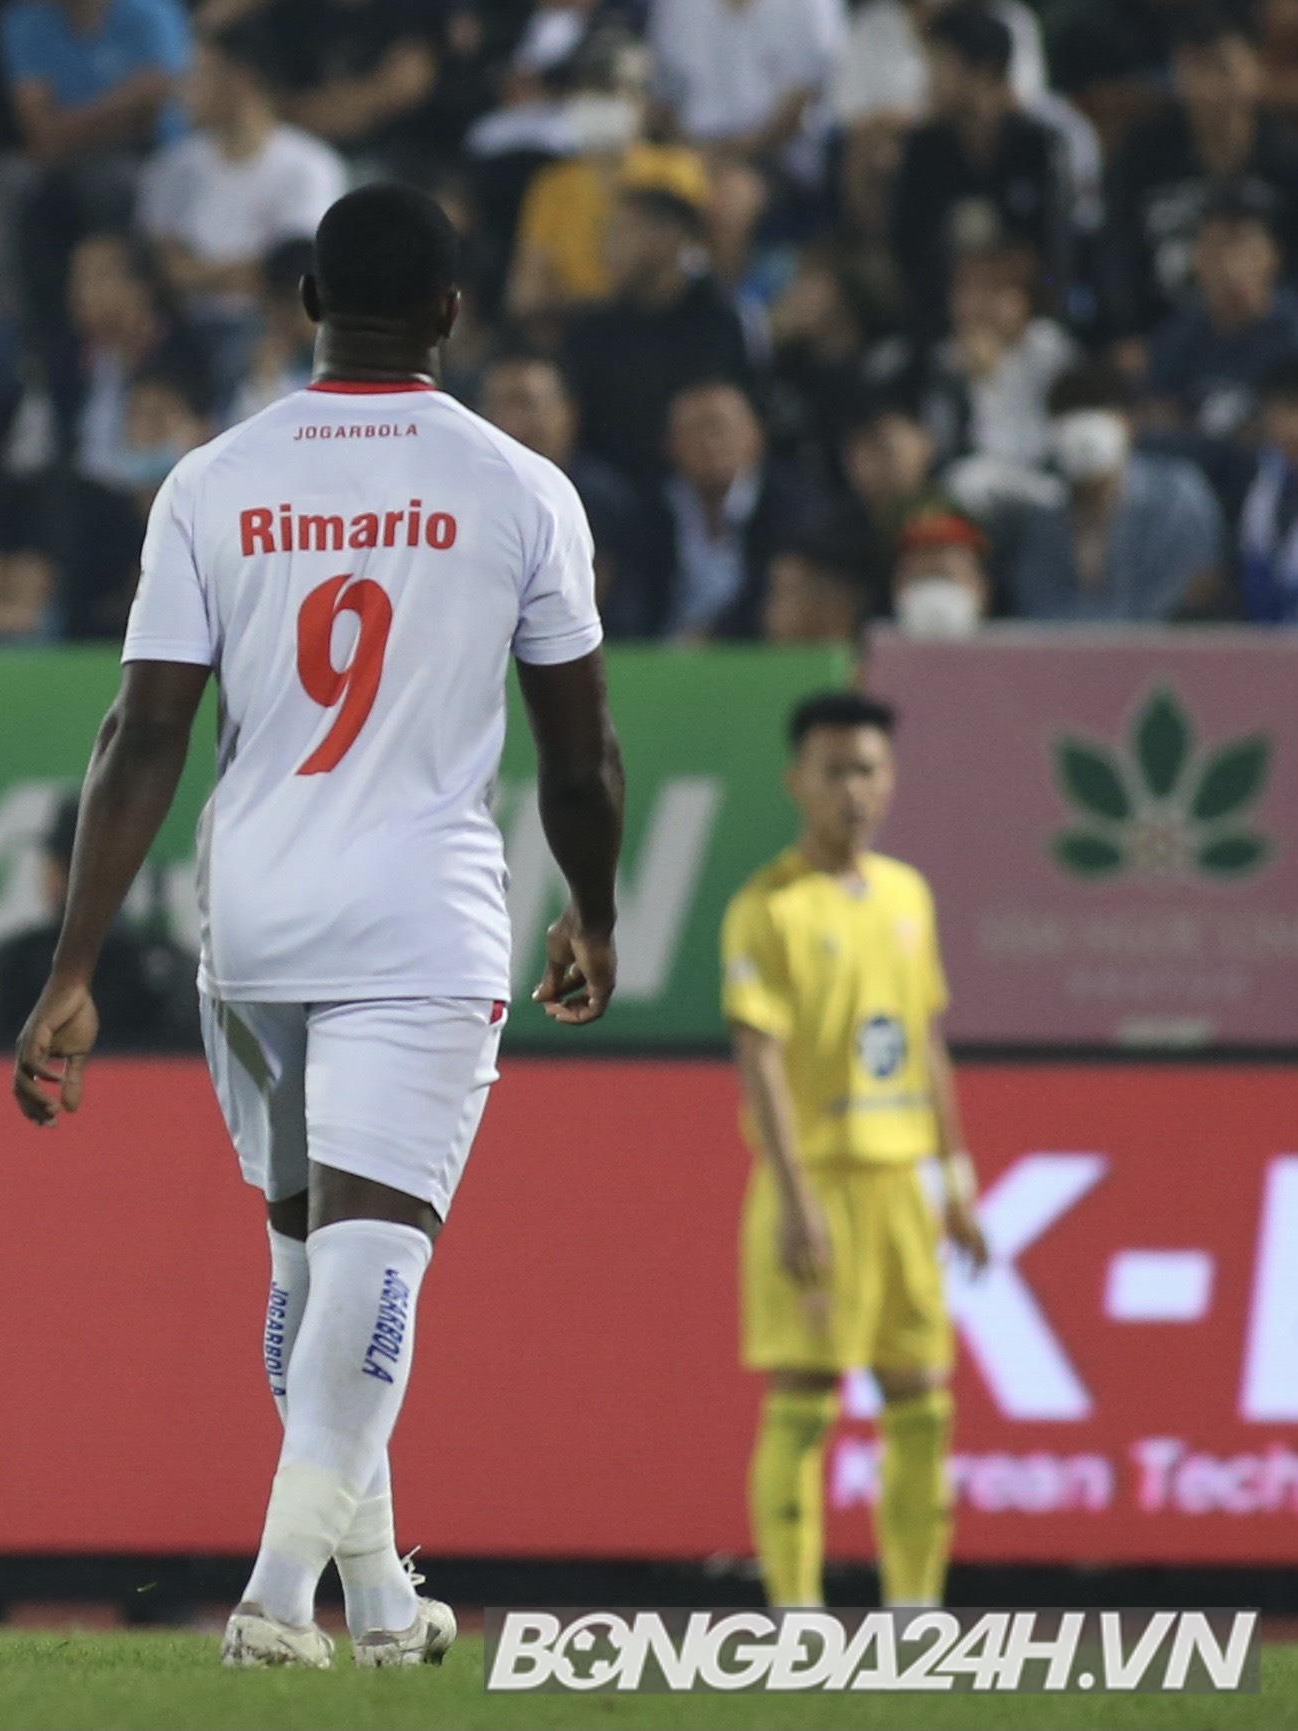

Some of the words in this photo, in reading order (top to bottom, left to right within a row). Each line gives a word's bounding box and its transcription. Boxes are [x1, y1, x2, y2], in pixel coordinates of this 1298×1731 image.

[293, 423, 418, 441] JOGARBOLA
[239, 499, 458, 557] Rimario
[295, 573, 393, 776] 9
[841, 1153, 1298, 1422] K-
